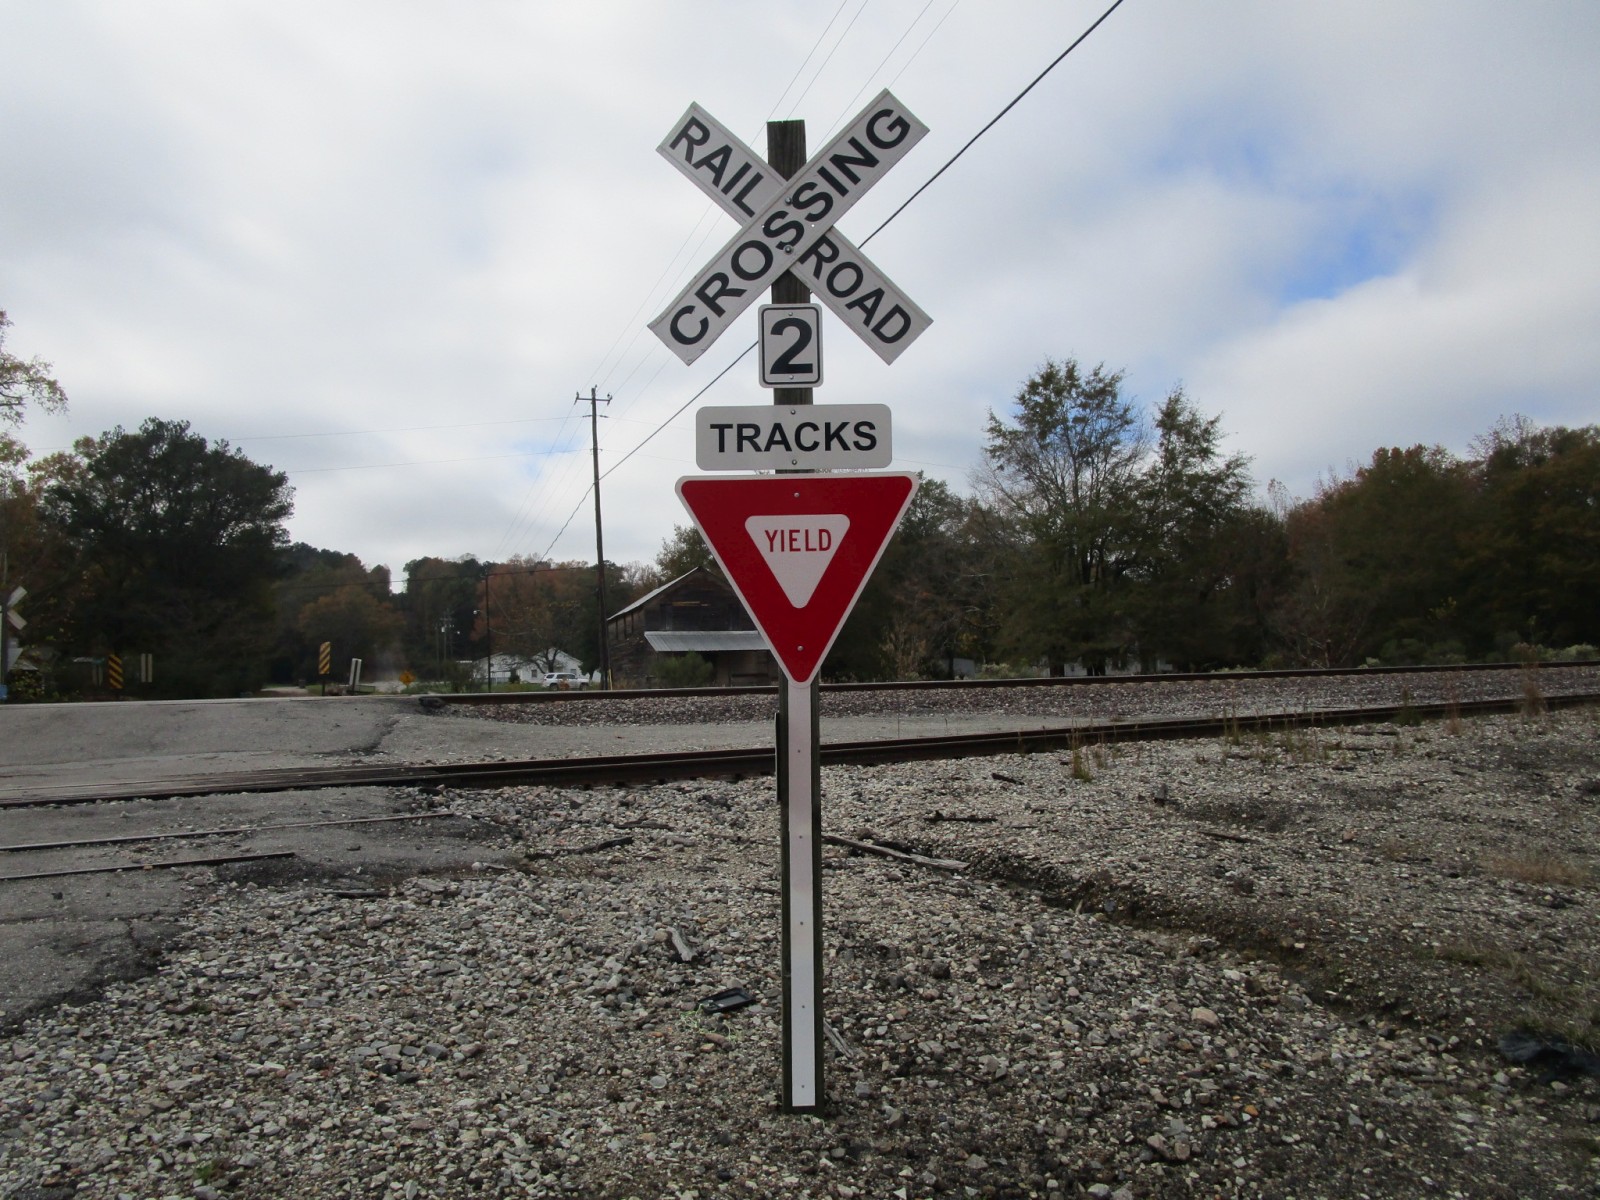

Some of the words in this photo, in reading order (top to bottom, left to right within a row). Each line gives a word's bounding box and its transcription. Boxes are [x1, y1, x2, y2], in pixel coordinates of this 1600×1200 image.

[669, 116, 764, 218] RAIL
[799, 234, 912, 344] ROAD
[670, 108, 911, 345] CROSSING
[770, 317, 813, 375] 2
[710, 421, 877, 453] TRACKS
[764, 528, 832, 552] YIELD
